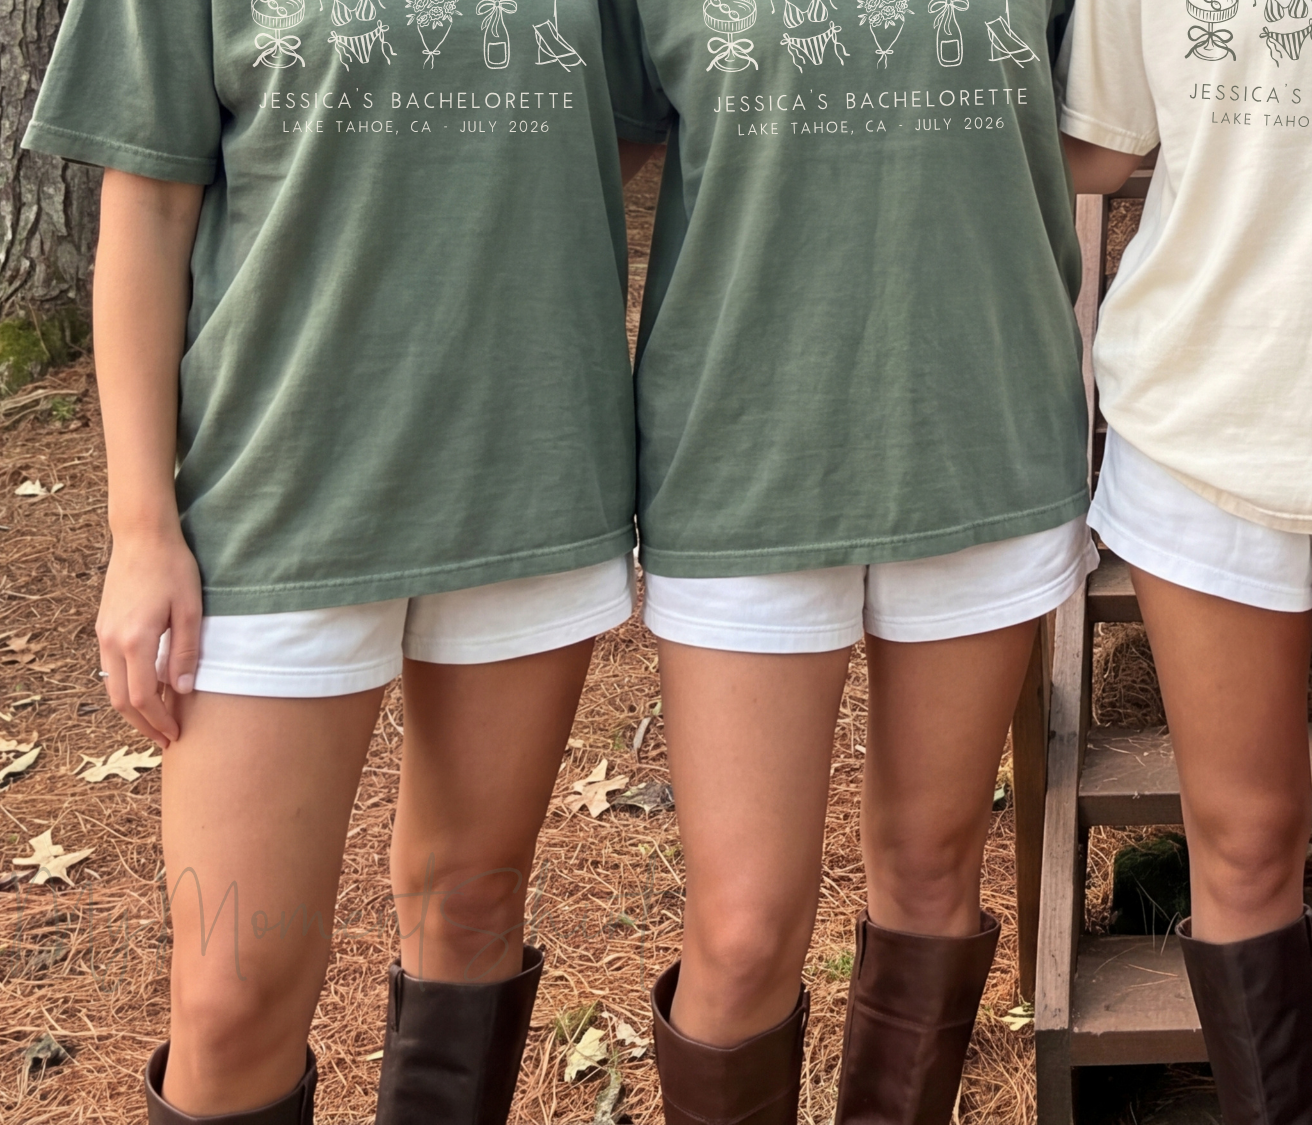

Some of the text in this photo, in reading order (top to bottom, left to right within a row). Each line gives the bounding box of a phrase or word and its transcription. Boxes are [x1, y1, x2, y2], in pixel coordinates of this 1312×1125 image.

[259, 87, 573, 110] JESSICA'S BACHELORETTE
[713, 88, 1028, 113] JESSICA'S BACHELORETTE
[1189, 83, 1302, 105] JESSICA'S
[282, 120, 324, 134] LAKE
[335, 120, 400, 136] TAHOE,
[410, 120, 432, 134] CA
[460, 120, 498, 134] JULY
[508, 120, 550, 134] 2026
[737, 122, 779, 136] LAKE
[790, 120, 854, 135] TAHOE,
[865, 119, 887, 133] CA
[915, 117, 953, 131] JULY
[964, 116, 1005, 130] 2026
[1211, 111, 1252, 126] LAKE
